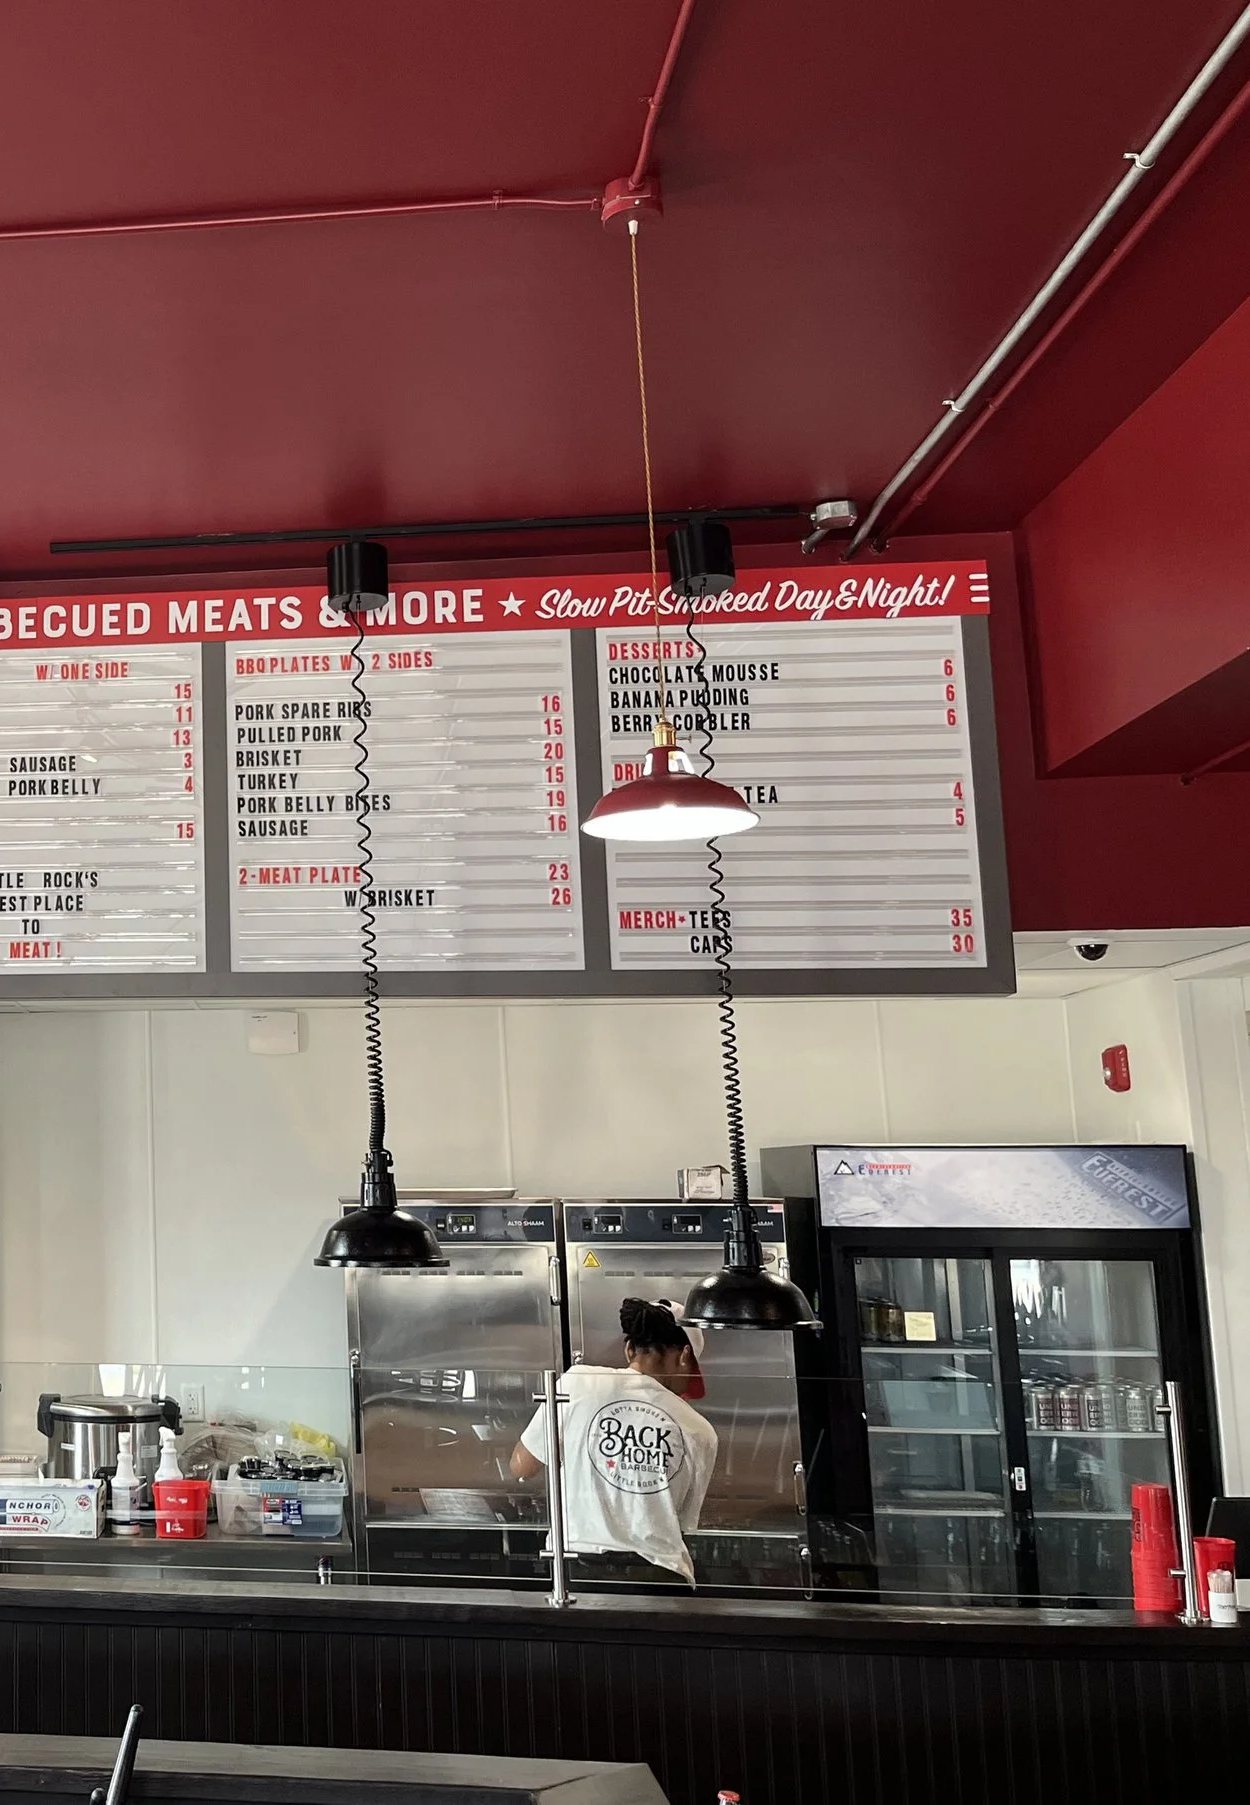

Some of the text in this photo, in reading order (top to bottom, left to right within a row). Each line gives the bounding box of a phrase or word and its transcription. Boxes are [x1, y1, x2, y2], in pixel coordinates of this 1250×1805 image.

[168, 596, 303, 634] MEATS
[366, 588, 484, 627] MORE
[535, 588, 607, 619] Slow
[372, 653, 380, 670] 2
[388, 651, 433, 669] SIDES
[609, 641, 694, 661] DESSERTS
[60, 663, 90, 680] ONE
[95, 662, 128, 678] SIDE
[712, 662, 780, 682] MOUSSE
[943, 659, 953, 677] 6
[174, 683, 192, 699] 15
[611, 684, 955, 708] BANANA 6
[175, 706, 193, 723] 11
[235, 703, 275, 721] PORK
[281, 702, 330, 719] SPARE
[541, 695, 561, 713] 16
[946, 709, 956, 726] 6
[173, 730, 191, 746] 13
[237, 718, 563, 744] PULLED PORK 15
[9, 755, 76, 773] SAUSAGE
[183, 752, 193, 768] 3
[236, 742, 564, 767] BRISKET 20
[184, 776, 193, 792] 4
[237, 766, 564, 791] TURKEY 15
[237, 797, 277, 814] PORK
[284, 795, 335, 813] BELLY
[546, 790, 565, 807] 19
[744, 782, 963, 804] TEA 4
[238, 814, 567, 838] SAUSAGE 16
[955, 808, 965, 826] 5
[177, 822, 194, 839] 15
[43, 871, 98, 888] ROCK'S
[239, 864, 570, 885] 2-MEAT PLATE 23
[33, 895, 84, 912] PLACE
[368, 887, 571, 907] BRISKET 26
[22, 919, 40, 935] TO
[620, 909, 973, 929] MERCH 35
[952, 935, 974, 953] 30
[621, 1447, 669, 1468] HOME
[12, 1515, 49, 1526] WRAP
